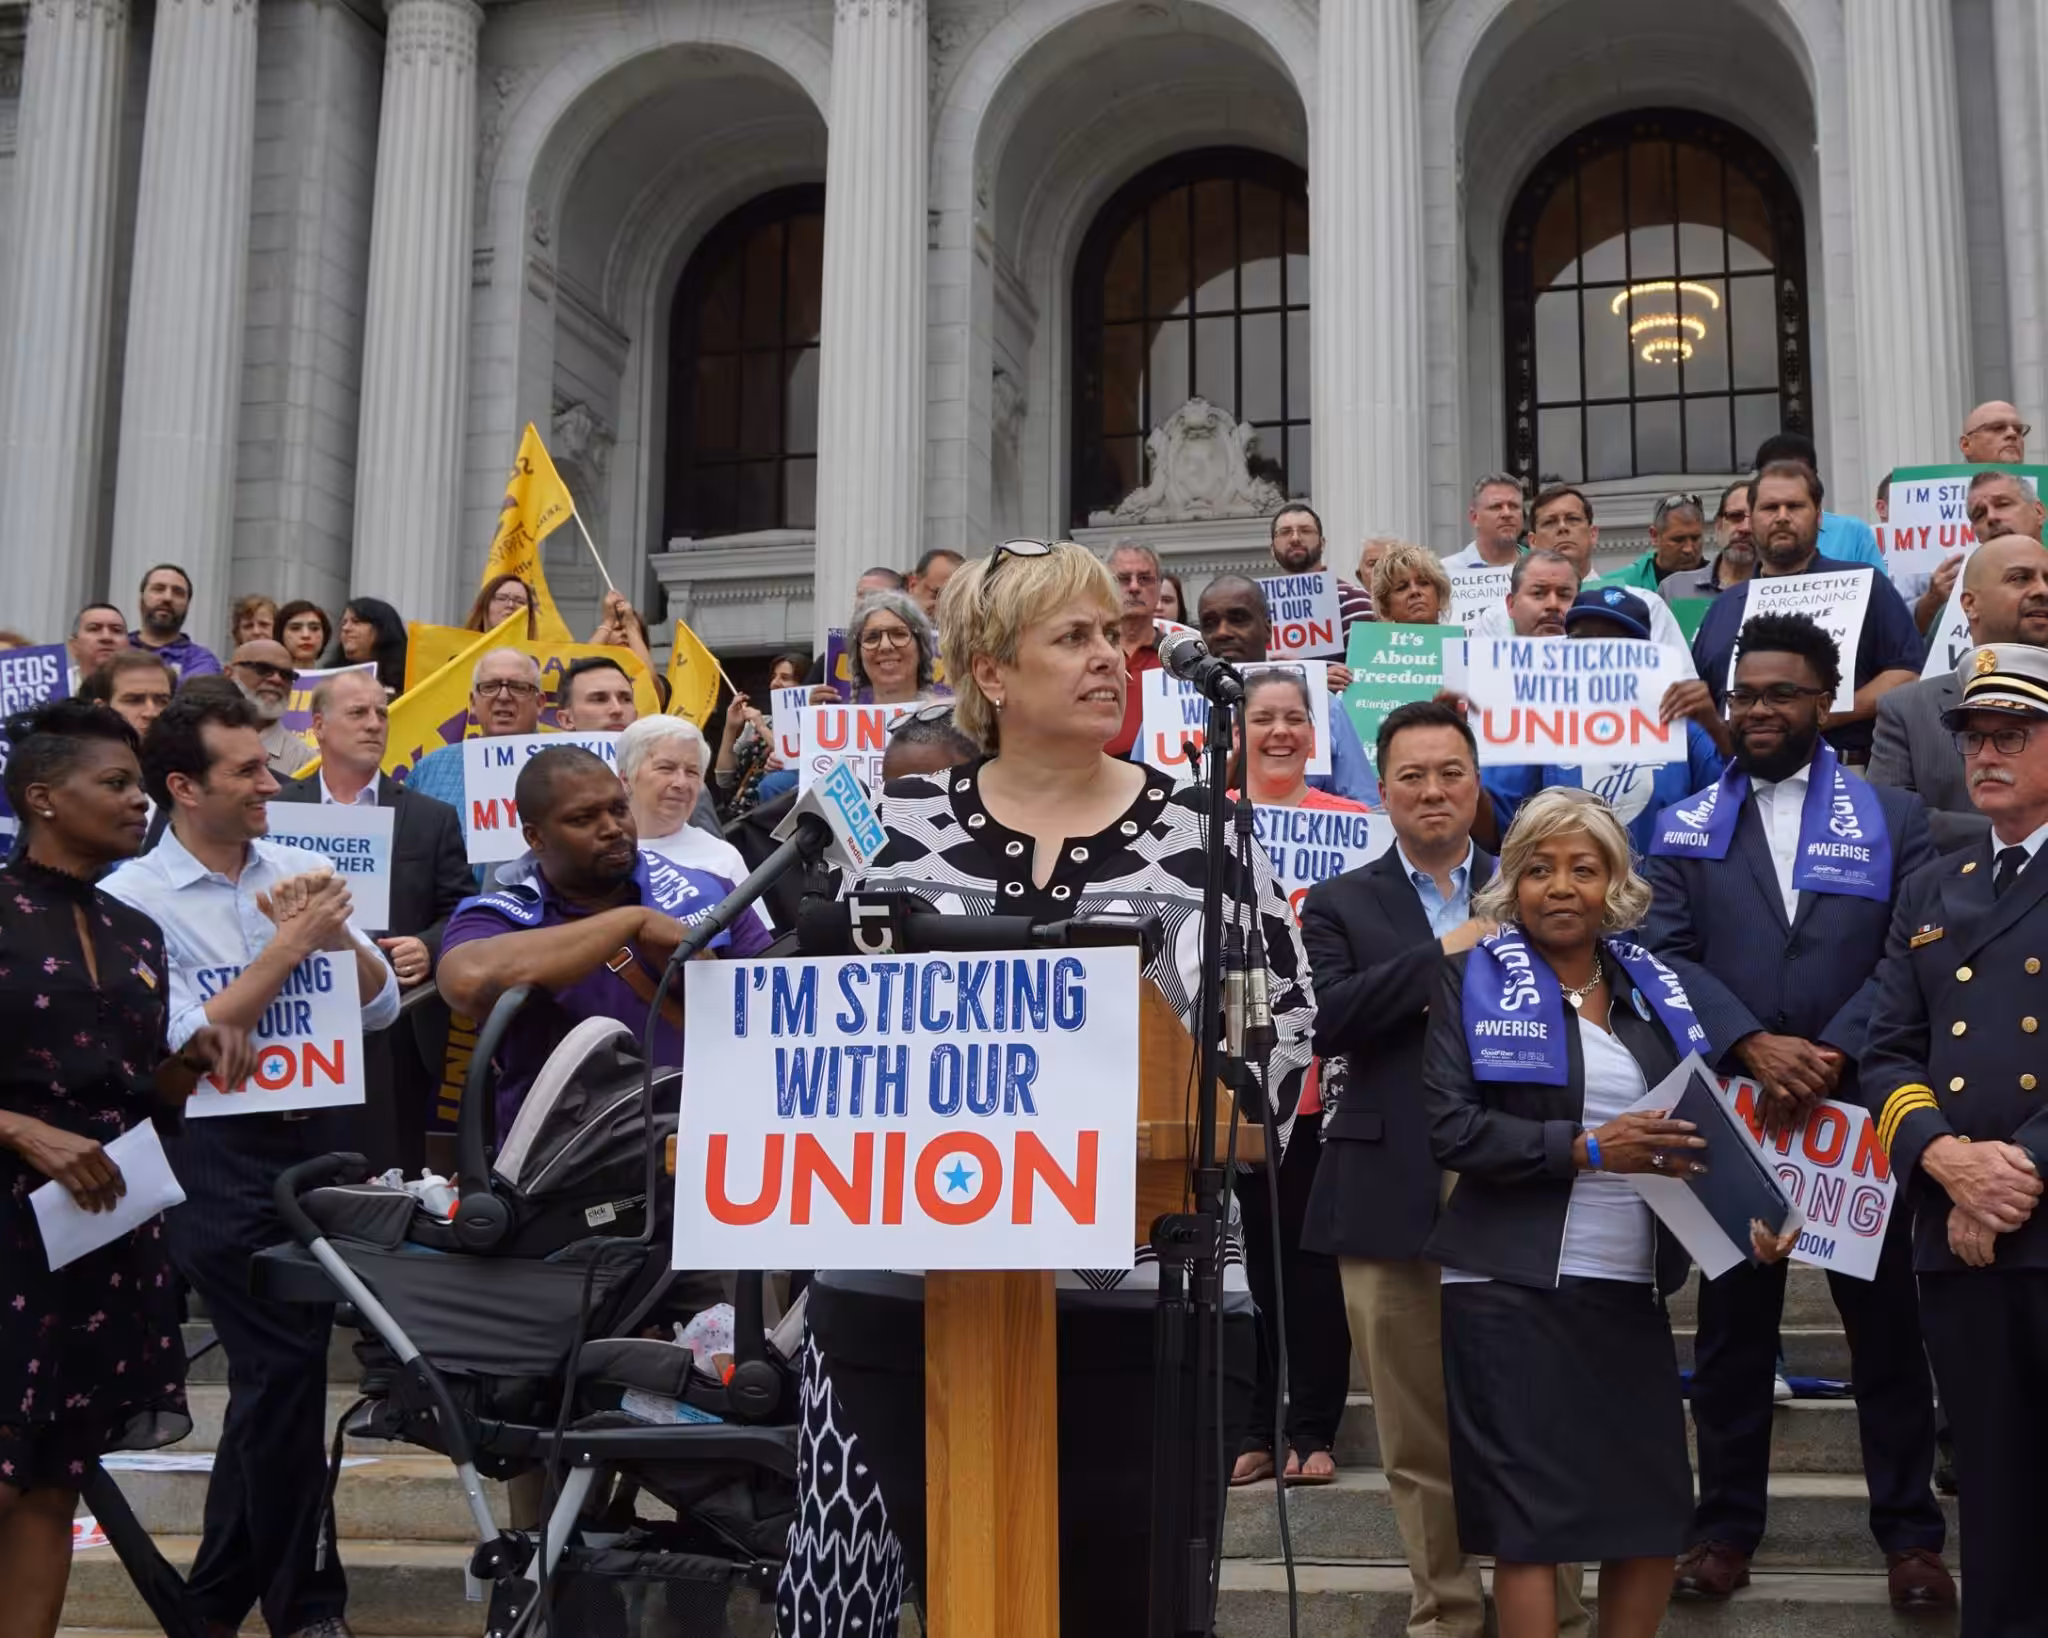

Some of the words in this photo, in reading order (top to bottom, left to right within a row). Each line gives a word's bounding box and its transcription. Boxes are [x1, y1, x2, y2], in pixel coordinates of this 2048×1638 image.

[1938, 485, 1966, 501] STI
[1894, 525, 1932, 551] MY
[1257, 574, 1323, 600] TICKING
[1760, 577, 1861, 596] COLLECTIVE
[1282, 599, 1314, 621] OUR
[1757, 590, 1858, 610] BARGAINING
[1265, 618, 1334, 651] ION
[1390, 631, 1424, 646] It's
[1371, 650, 1438, 666] About
[1493, 641, 1532, 670] I'M
[1543, 641, 1660, 671] STICKING
[1352, 668, 1443, 685] Freedom
[1513, 673, 1579, 703] WITH
[1588, 673, 1639, 703] OUR
[783, 689, 808, 709] I'M
[1482, 708, 1669, 746] UNION
[484, 745, 514, 768] I'M
[473, 799, 519, 831] MY
[831, 768, 878, 854] public
[1252, 807, 1369, 850] STICKING
[1663, 831, 1710, 848] #UNION
[1293, 848, 1346, 882] OUR
[1808, 842, 1870, 863] #WERISE
[734, 965, 818, 1038] I'M
[836, 956, 1087, 1036] STICKING
[257, 1000, 313, 1039] OUR
[1475, 1019, 1548, 1040] #WERISE
[775, 1044, 910, 1119] WITH
[929, 1042, 1040, 1118] OUR
[705, 1130, 1100, 1226] UNION
